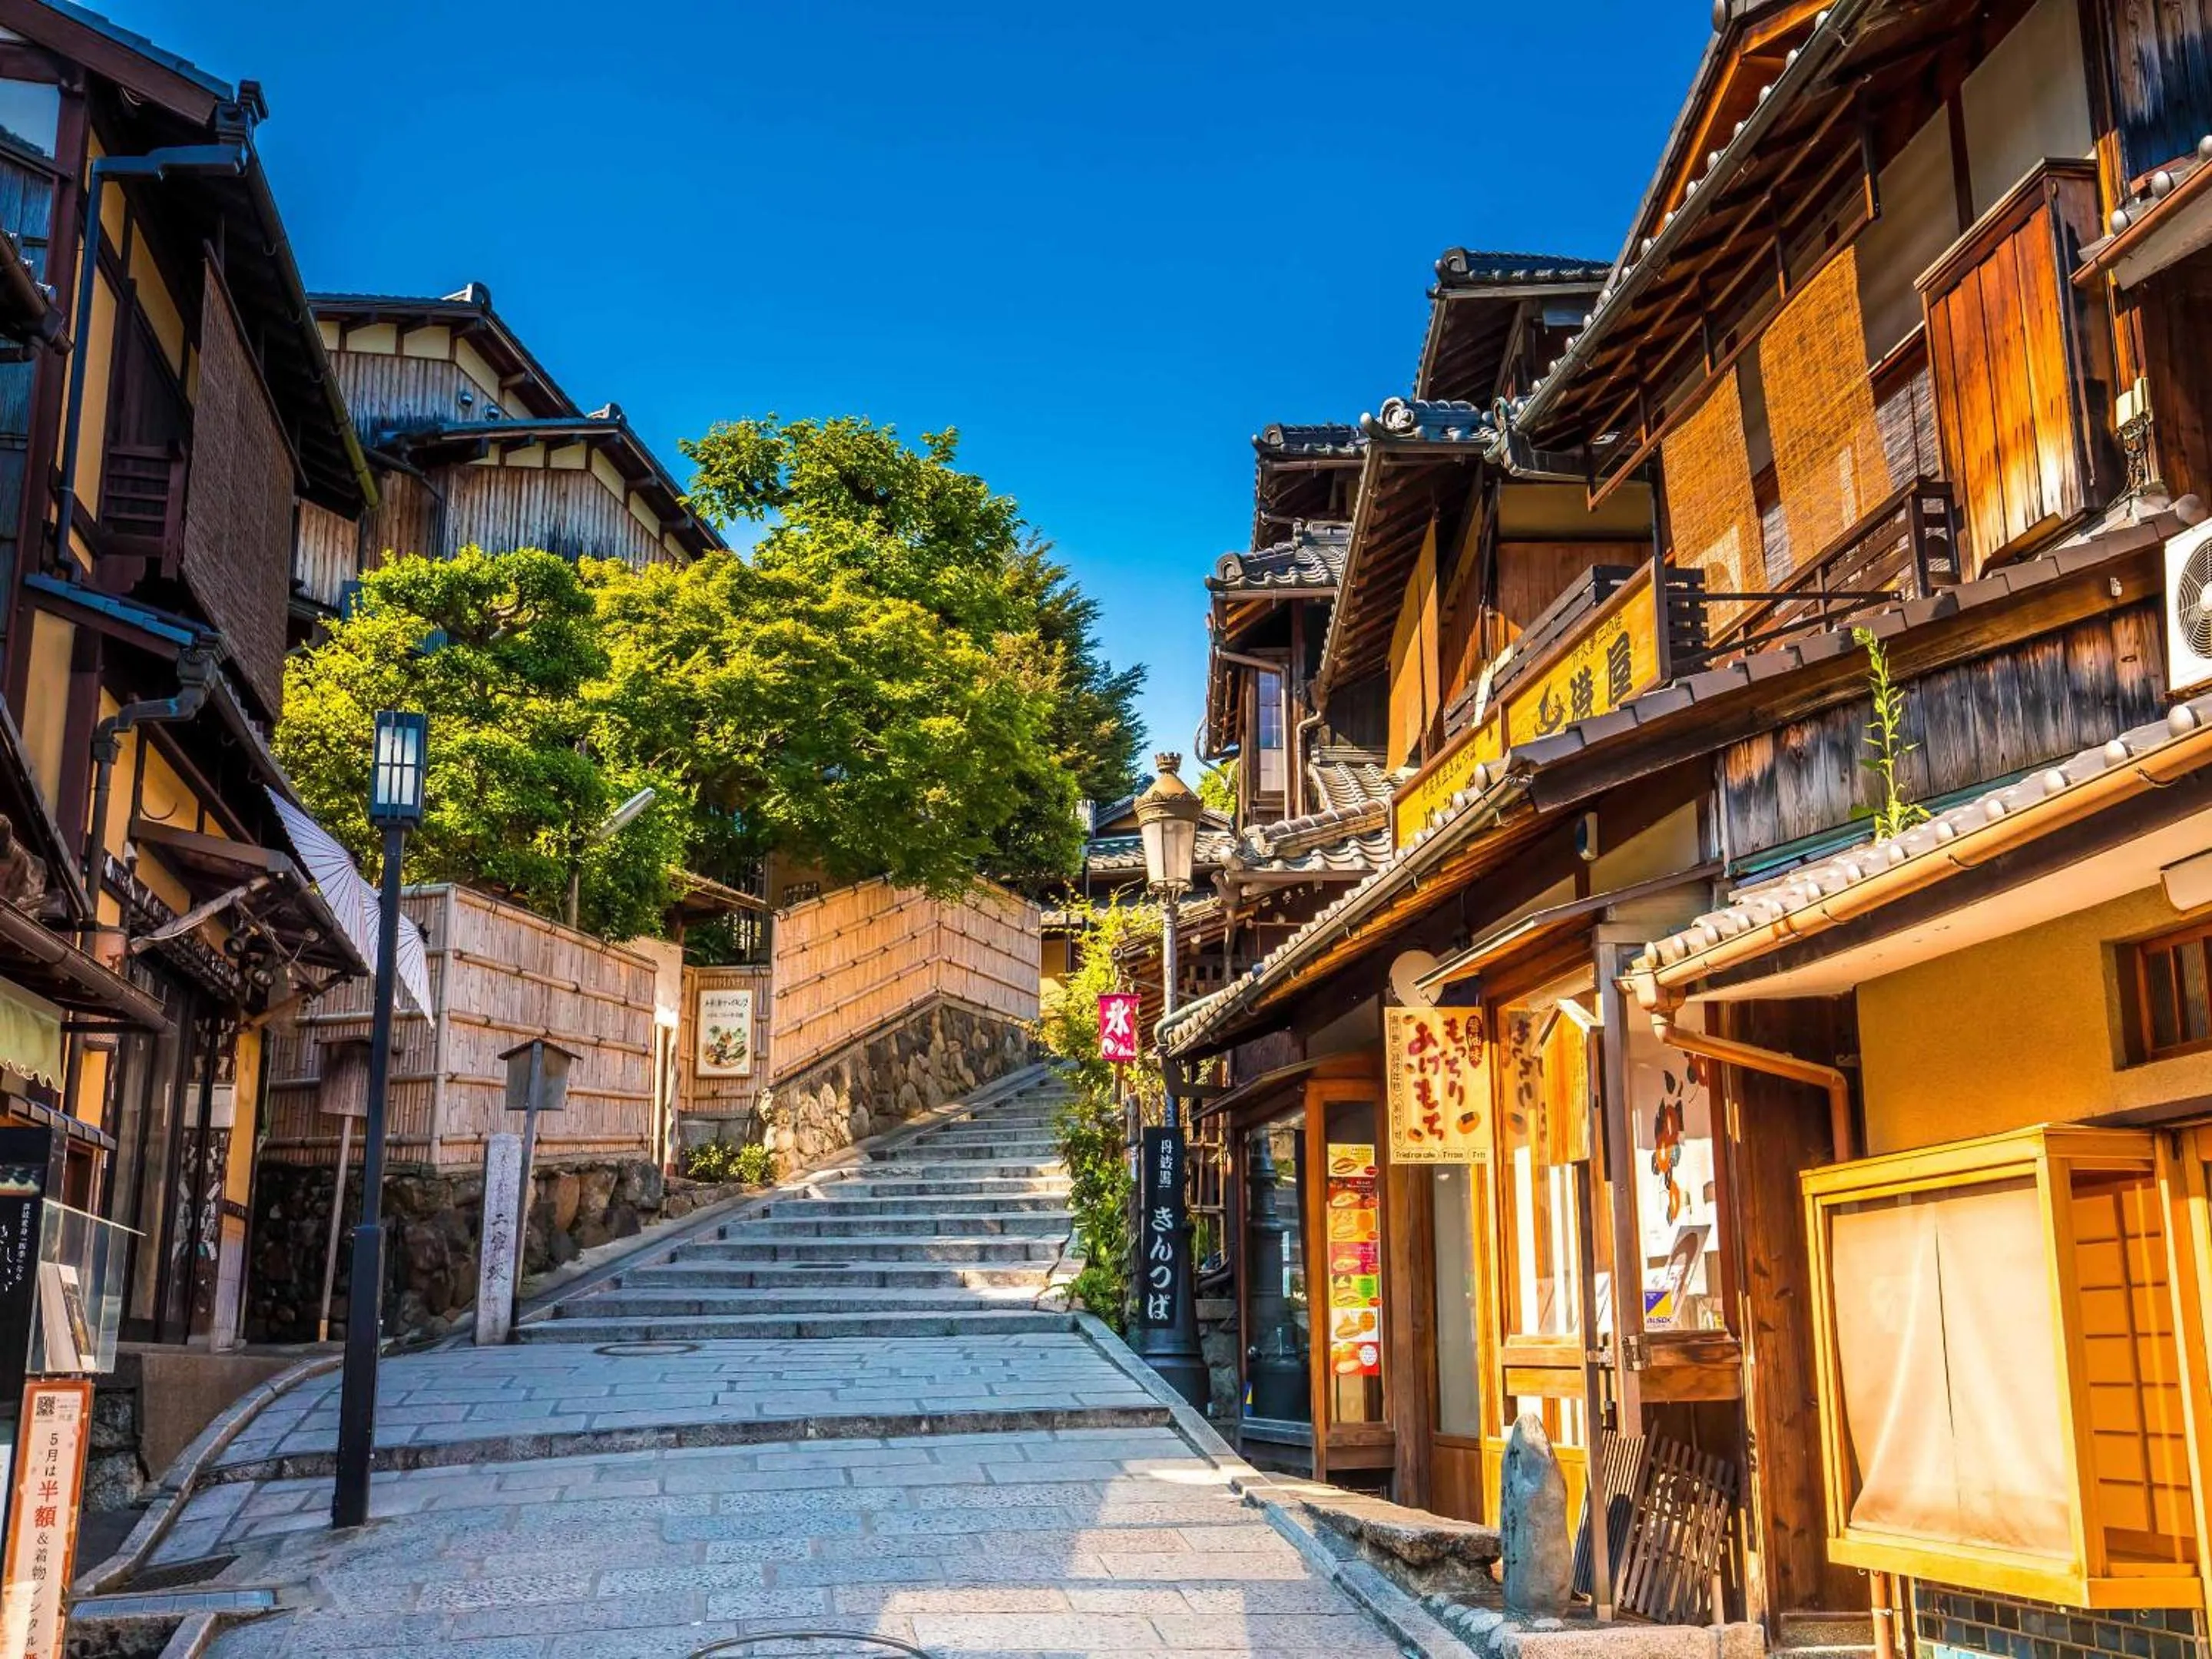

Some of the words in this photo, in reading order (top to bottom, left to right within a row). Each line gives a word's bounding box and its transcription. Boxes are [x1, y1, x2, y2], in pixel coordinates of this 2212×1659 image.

[1104, 998, 1131, 1038] 氷
[1408, 1022, 1444, 1141] あげもち
